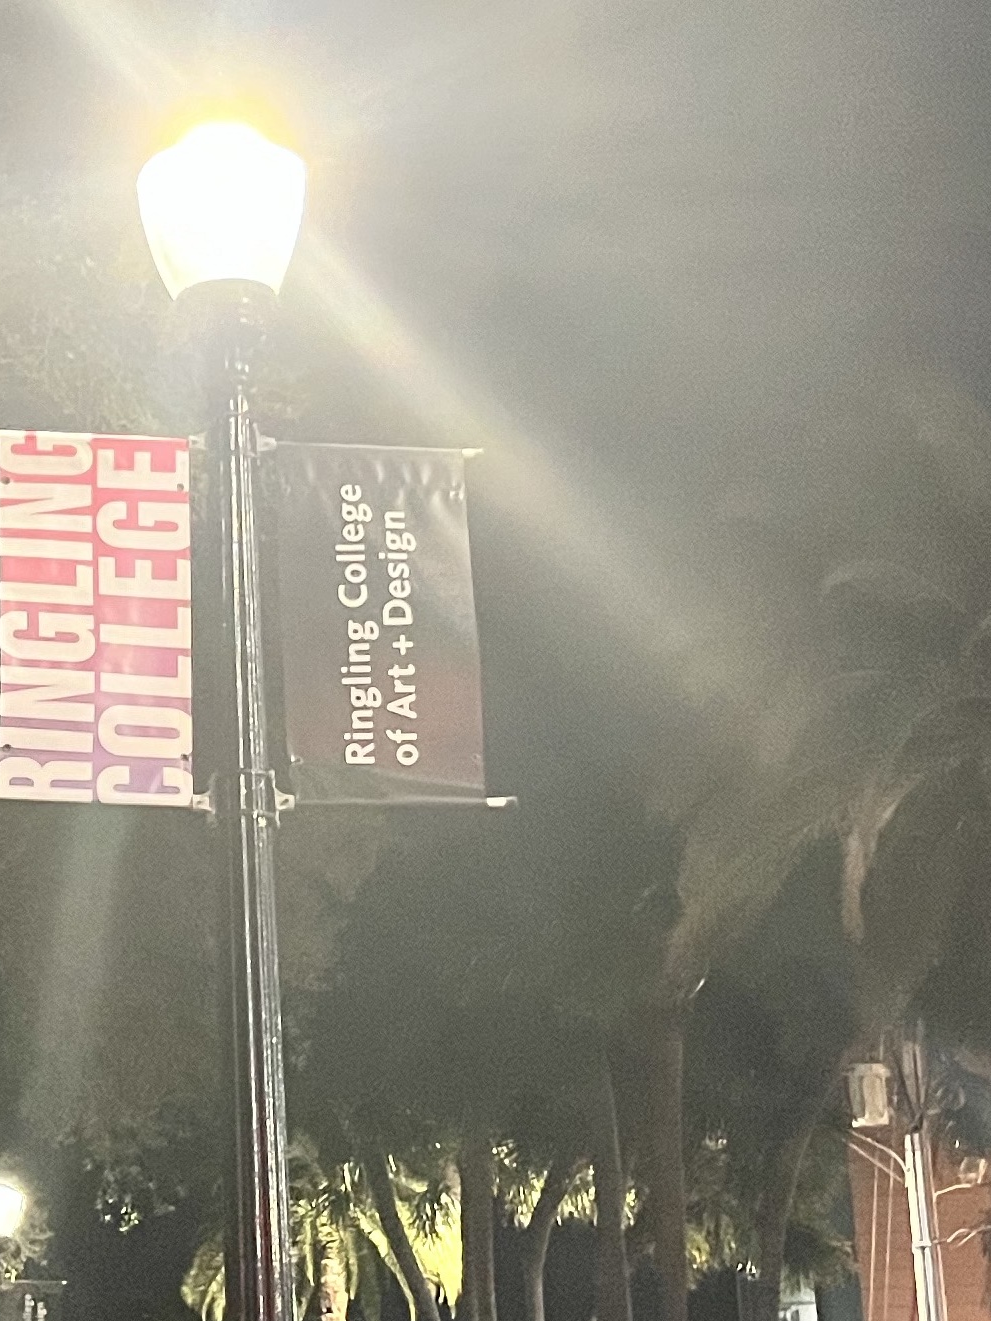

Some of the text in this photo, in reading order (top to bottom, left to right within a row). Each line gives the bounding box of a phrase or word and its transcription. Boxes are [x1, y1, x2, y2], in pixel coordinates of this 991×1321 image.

[334, 483, 382, 766] Ringling College
[378, 509, 417, 627] Design
[96, 448, 194, 807] COLLEGE
[385, 722, 419, 766] of
[387, 664, 418, 720] Art
